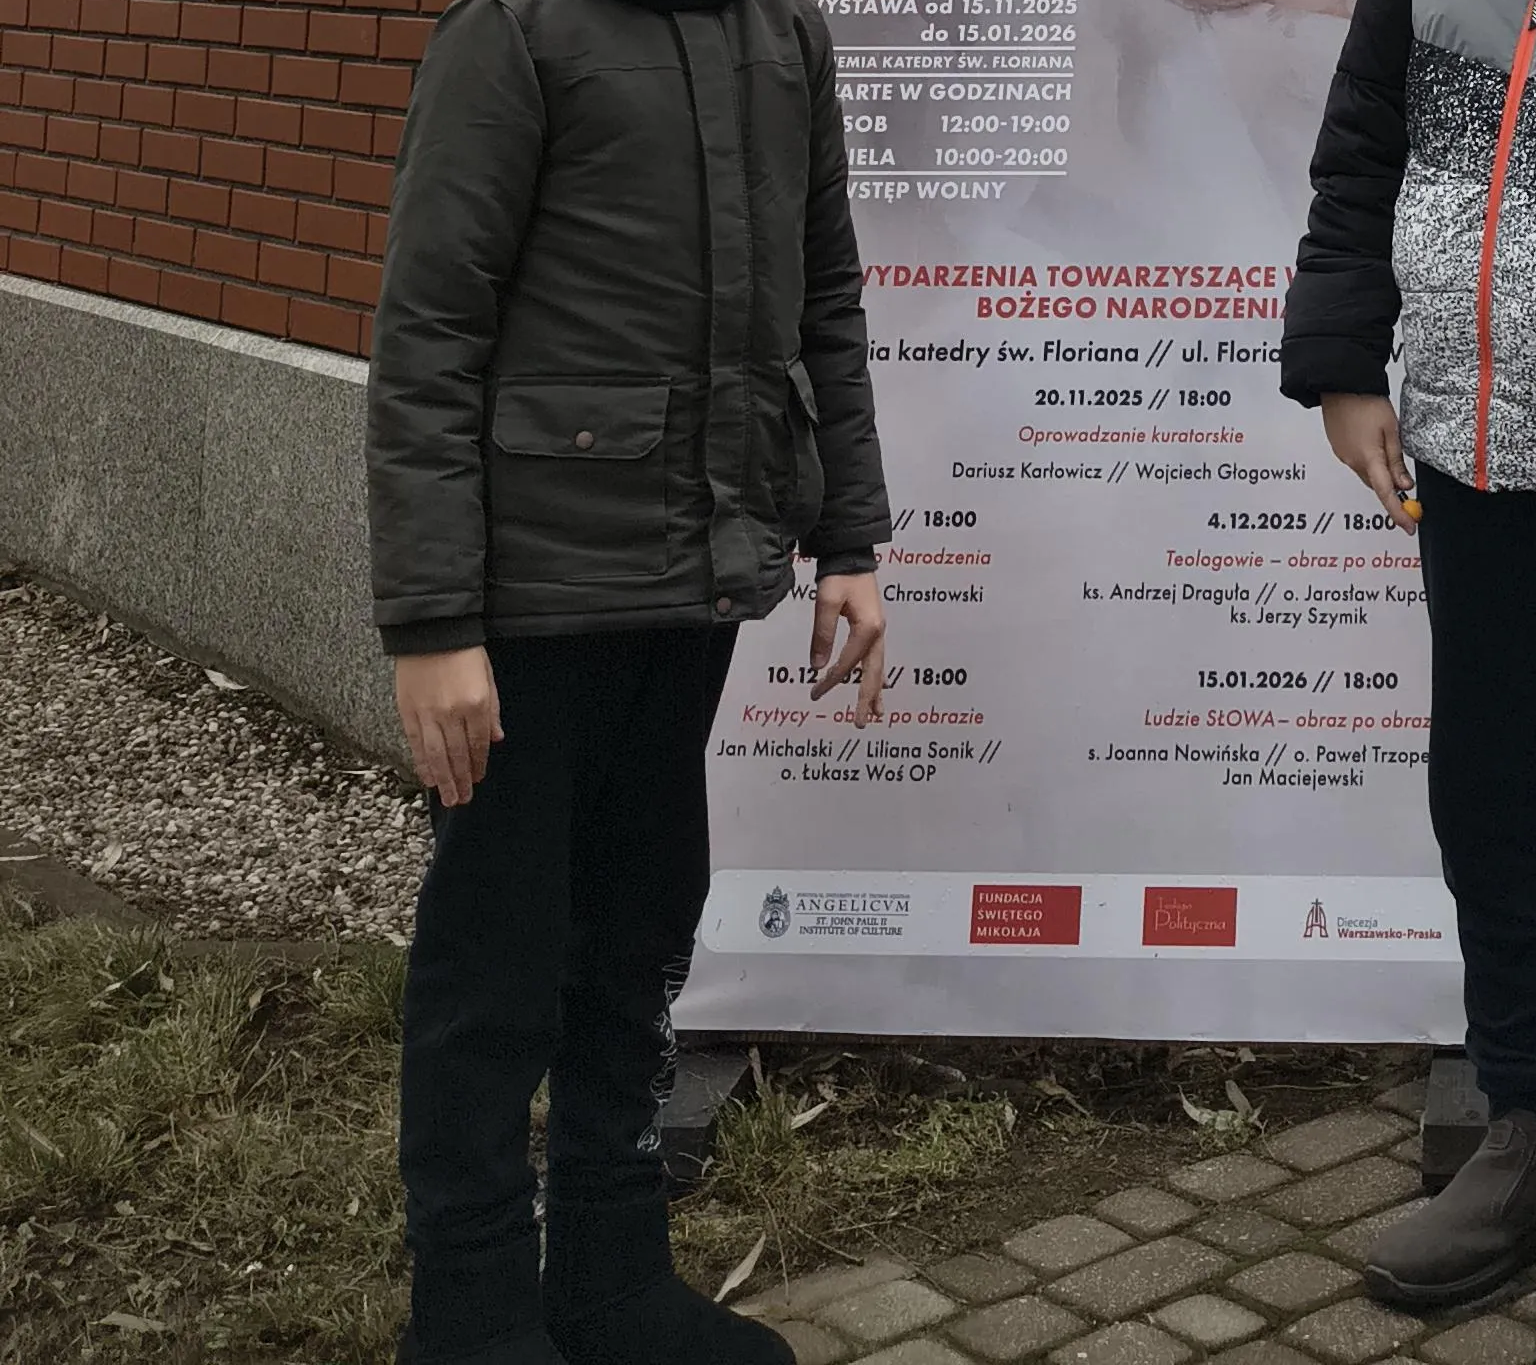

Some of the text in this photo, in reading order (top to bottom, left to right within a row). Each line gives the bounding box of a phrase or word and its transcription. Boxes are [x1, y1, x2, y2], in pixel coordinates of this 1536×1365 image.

[921, 23, 1076, 43] do 15.01.2026
[883, 56, 953, 68] KATEDRY
[958, 53, 987, 68] ŚW.
[991, 56, 1073, 69] FLORIANA
[900, 84, 922, 100] W
[929, 84, 1071, 101] GODZINACH
[940, 115, 1070, 133] 12:00-19:00
[848, 148, 1067, 166] IELA 10:00-20:00
[916, 181, 1006, 199] WOLNY
[1047, 266, 1276, 293] TOWARZYSZĄCE
[978, 291, 1096, 318] BOŻEGO
[899, 339, 990, 368] katedry
[998, 341, 1033, 361] św.
[1044, 340, 1138, 362] Floriana
[1183, 340, 1208, 362] ul.
[1035, 390, 1142, 405] 20.11.2025
[1179, 390, 1231, 406] 18:00
[1019, 425, 1243, 447] Oprowadzanie kuratorskie
[953, 462, 1014, 478] Dariusz
[1021, 462, 1101, 478] Karłowicz
[1136, 463, 1211, 484] Wojciech
[1218, 463, 1305, 484] Głogowski
[925, 511, 976, 527] 18:00
[1208, 513, 1306, 529] 4.12.2025
[1343, 511, 1397, 531] 18:00
[889, 548, 991, 564] Narodzenia
[1167, 549, 1263, 571] Teologowie
[1288, 550, 1338, 567] obraz
[1343, 557, 1365, 572] po
[1371, 550, 1422, 570] obraz
[884, 584, 983, 602] Chrostowski
[1084, 582, 1103, 599] ks.
[1110, 582, 1176, 604] Andrzej
[1183, 583, 1249, 605] Draguła
[1284, 590, 1298, 601] o.
[1305, 584, 1379, 601] Jarosław
[1231, 606, 1367, 629] ks. Jerzy Szymik
[914, 668, 967, 685] 18:00
[1199, 671, 1307, 688] 15.01.2026
[1344, 672, 1398, 689] 18:00
[743, 705, 809, 727] Krytycy
[889, 712, 911, 728] po
[918, 706, 983, 724] obrazie
[1145, 708, 1199, 726] Ludzie
[1296, 709, 1347, 727] obraz
[1352, 717, 1374, 732] po
[1381, 711, 1431, 730] obraz
[716, 739, 747, 757] Jan
[753, 739, 832, 757] Michalski
[867, 740, 921, 758] Liliana
[928, 741, 974, 758] Sonik
[1088, 749, 1099, 760] s.
[1106, 744, 1168, 760] Joanna
[1175, 744, 1259, 761] Nowińska
[1294, 751, 1309, 762] o.
[1317, 745, 1366, 762] Paweł
[1371, 745, 1429, 770] Trzope
[781, 762, 936, 781] o. Łukasz Woś OP
[1223, 768, 1363, 790] Jan Maciejewski
[796, 899, 908, 912] ANGELICVM
[978, 893, 1042, 903] FUNDACJA
[978, 910, 1042, 921] ŚWIĘTEGO
[1337, 916, 1378, 929] Diecezja
[799, 926, 845, 935] INSTITUTE
[861, 926, 903, 936] CULTURE
[1337, 927, 1442, 940] Warszawsko-Praska
